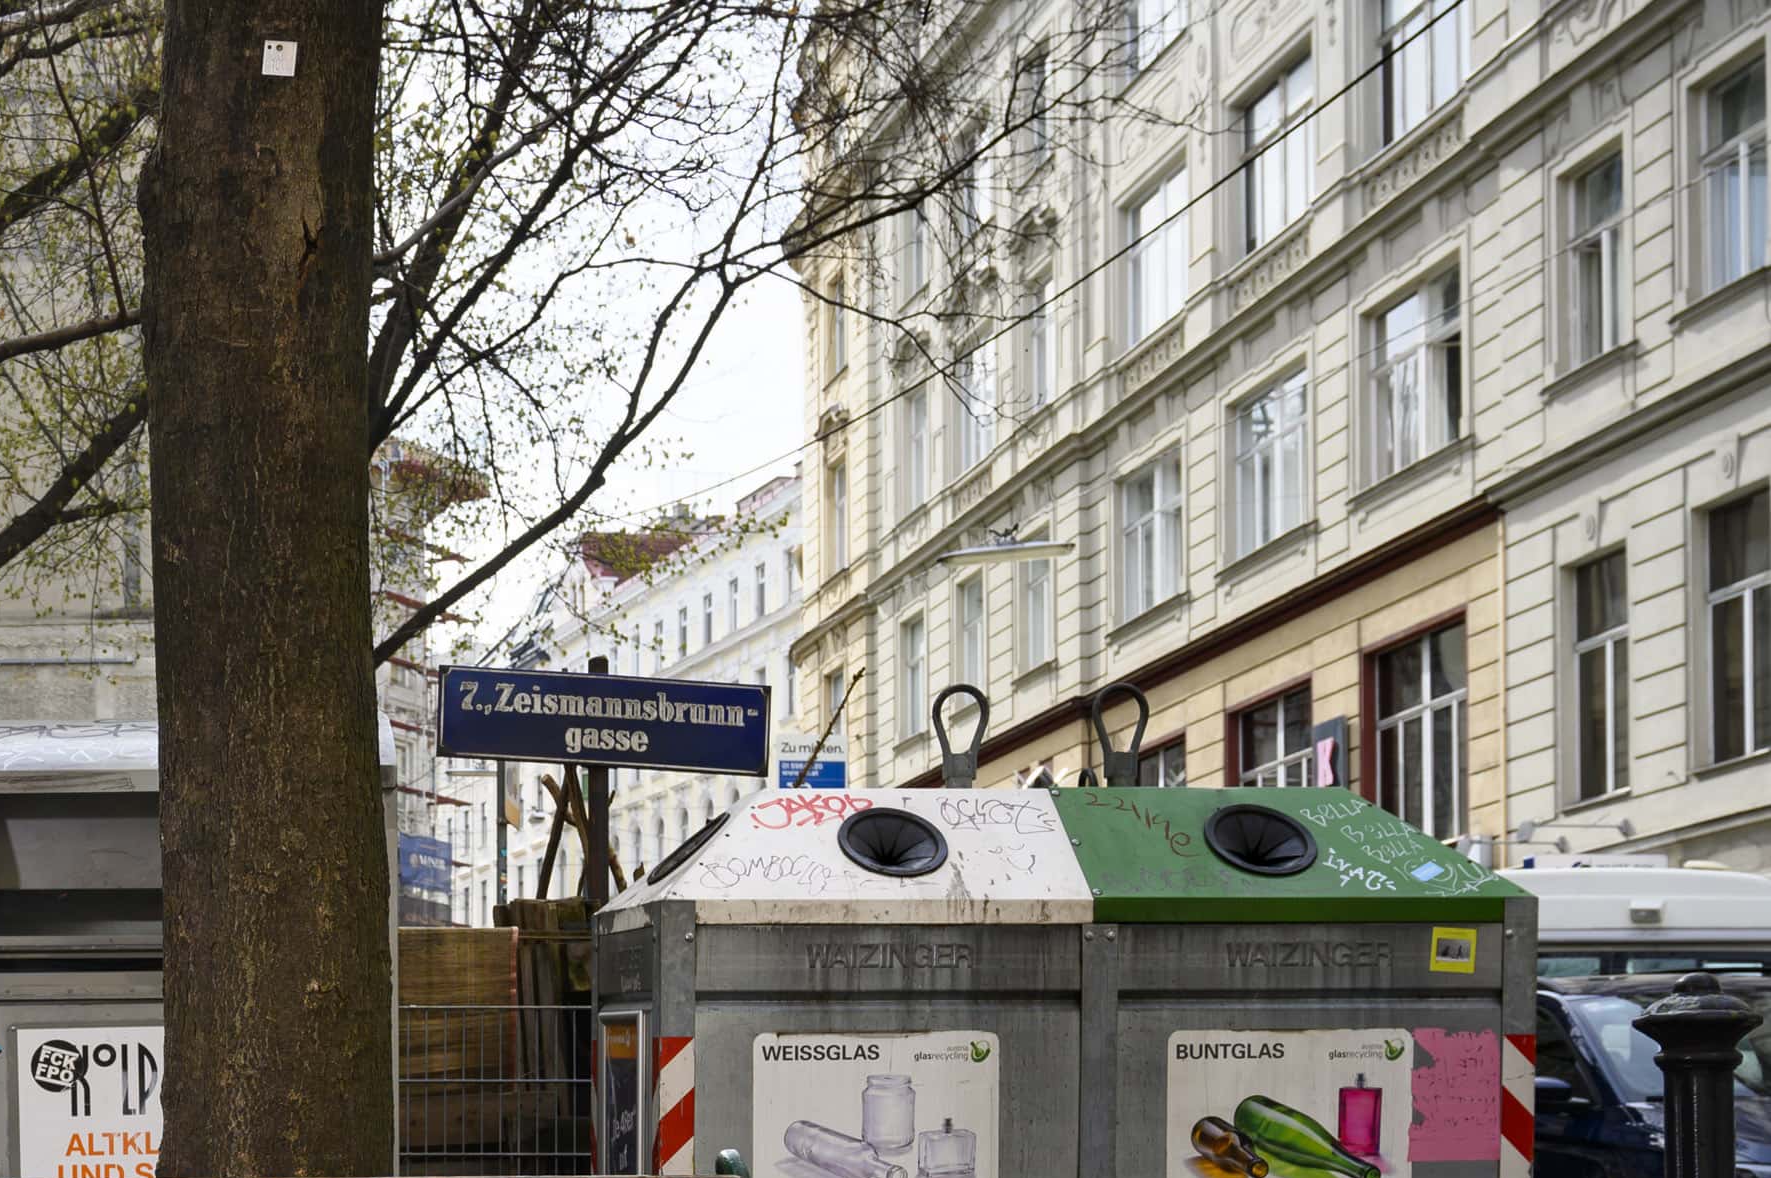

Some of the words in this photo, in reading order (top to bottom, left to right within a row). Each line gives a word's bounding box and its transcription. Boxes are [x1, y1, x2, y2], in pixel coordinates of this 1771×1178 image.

[565, 727, 649, 753] gasse
[781, 742, 796, 753] Zu
[799, 742, 845, 754] miten.
[805, 943, 973, 969] WAIZINGER
[1226, 942, 1394, 968] WAIZINGER
[39, 1049, 78, 1070] FCK
[762, 1044, 881, 1061] WEISSGLAS
[914, 1050, 969, 1062] glasrecycling
[1175, 1042, 1285, 1060] BUNTGLAS
[1328, 1049, 1384, 1061] glasrecycling
